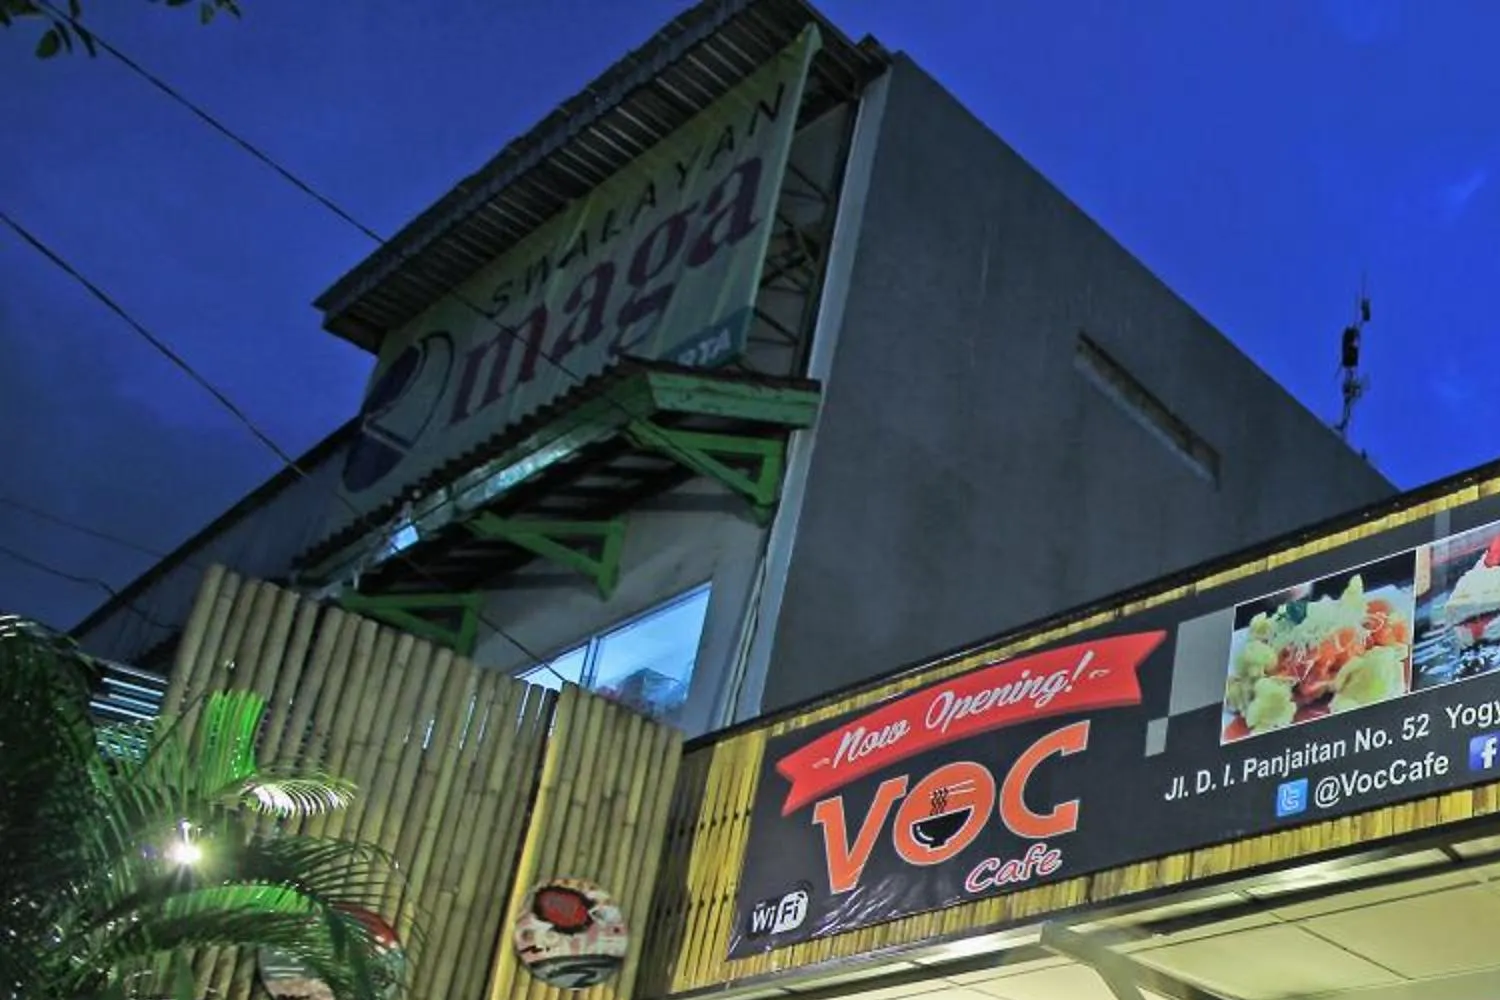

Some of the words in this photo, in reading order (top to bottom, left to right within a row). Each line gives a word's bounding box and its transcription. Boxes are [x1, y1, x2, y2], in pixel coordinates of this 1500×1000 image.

[449, 157, 764, 424] maga
[833, 719, 911, 769] Now
[924, 650, 1094, 733] Opening!
[1164, 777, 1189, 801] Jl.
[1196, 769, 1217, 794] D.
[1223, 763, 1235, 787] I.
[1243, 739, 1346, 782] Panjaitan
[1355, 727, 1393, 753] No.
[1401, 713, 1430, 741] 52
[813, 719, 1091, 894] VOC
[1315, 752, 1449, 808] @VocCafe
[965, 842, 1063, 893] Cafe
